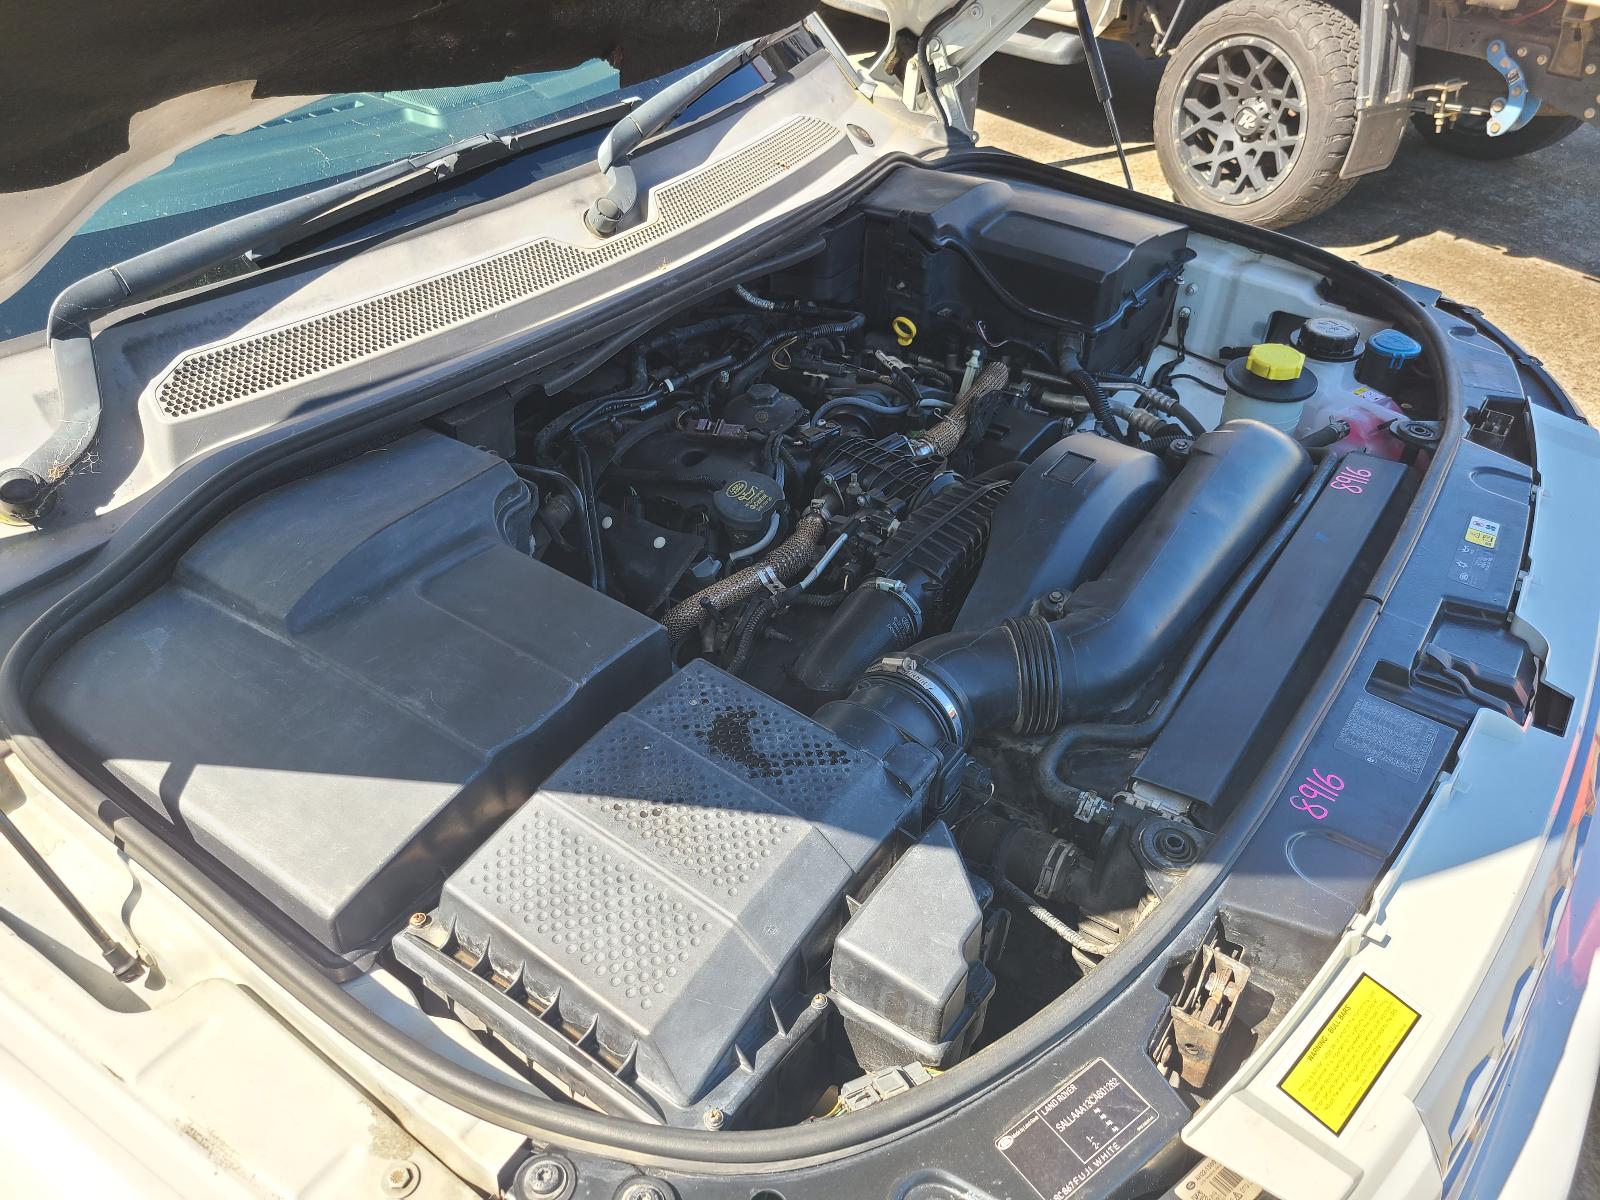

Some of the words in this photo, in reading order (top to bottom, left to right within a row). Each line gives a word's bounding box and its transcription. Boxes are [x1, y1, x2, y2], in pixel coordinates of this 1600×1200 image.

[1330, 466, 1372, 494] 8916
[1290, 768, 1345, 820] 8916
[1307, 1036, 1329, 1062] WARNING
[1328, 1020, 1342, 1035] BULL
[1338, 1005, 1352, 1020] BARS
[1041, 1096, 1059, 1116] LAND
[1056, 1084, 1078, 1103] ROVER
[1092, 1141, 1121, 1168] WHITE
